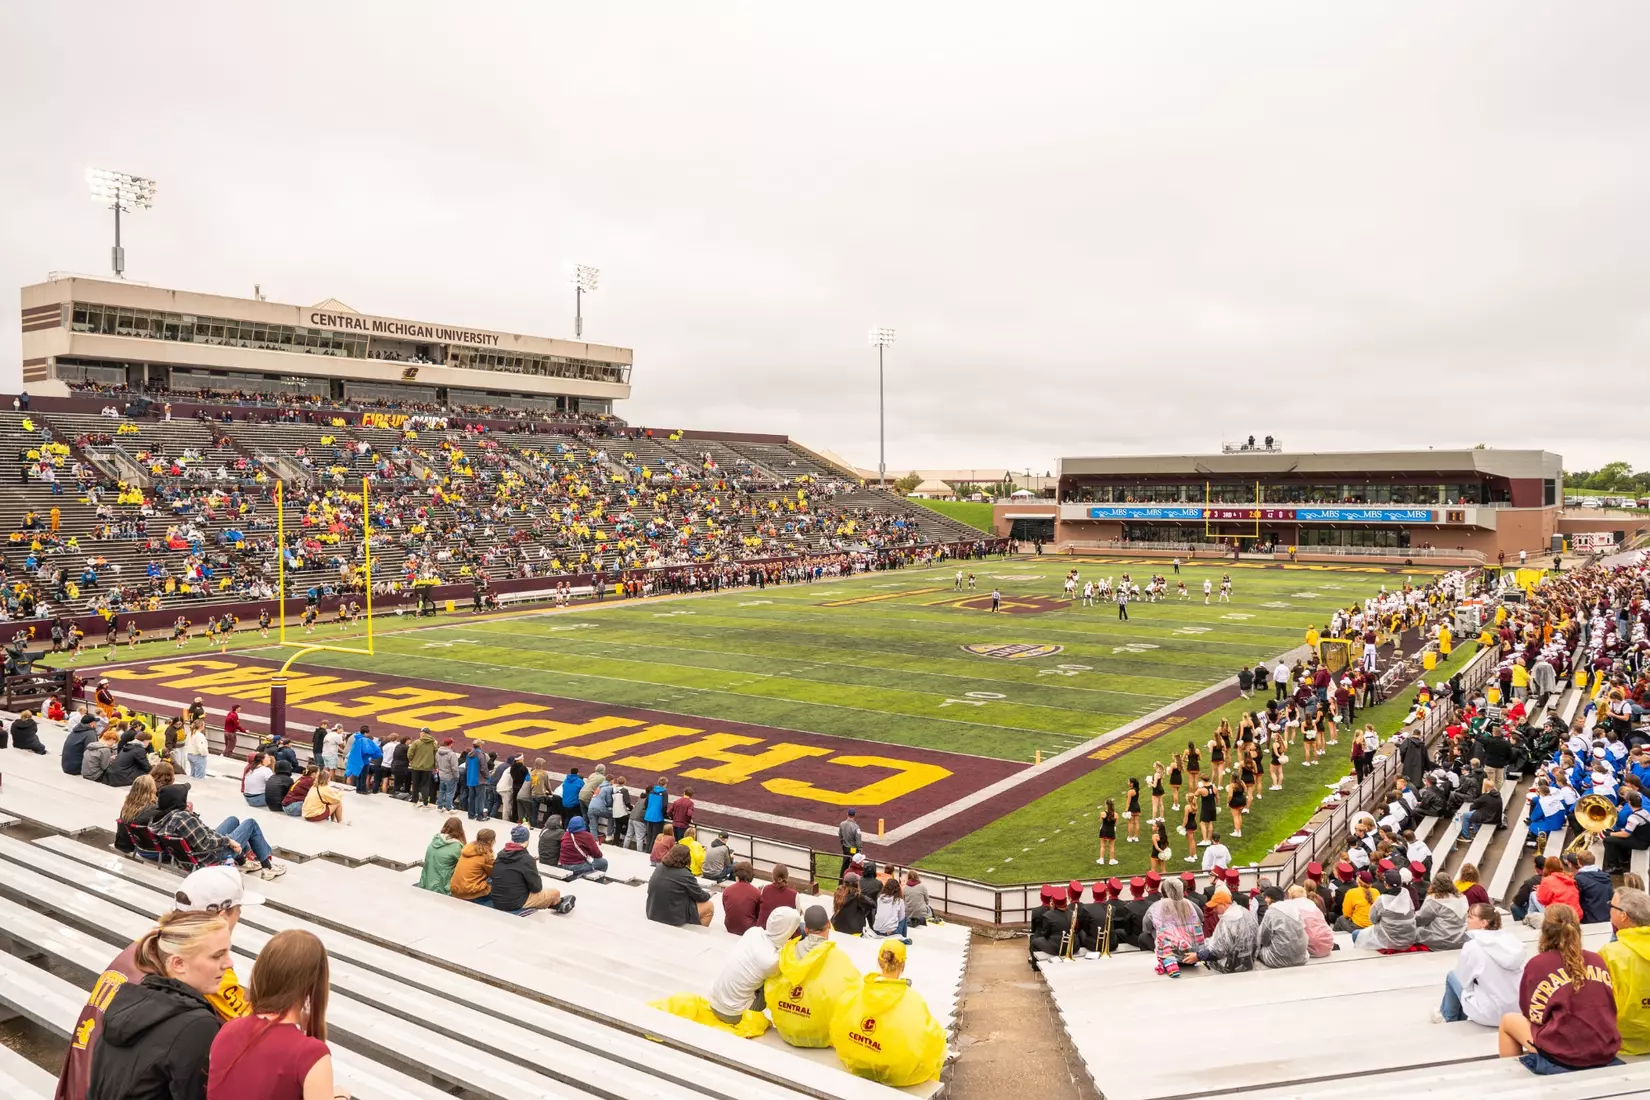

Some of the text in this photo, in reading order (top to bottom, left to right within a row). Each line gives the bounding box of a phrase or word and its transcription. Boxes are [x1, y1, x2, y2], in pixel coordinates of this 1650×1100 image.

[310, 312, 500, 346] CENTRAL MICHIGAN UNIVERSITY
[1111, 508, 1127, 516] MBS
[1146, 508, 1162, 516] MBS
[1182, 508, 1198, 516] MBS
[1321, 510, 1340, 518] MBS
[1363, 510, 1382, 518] MBS
[1407, 510, 1426, 518] MBS
[938, 691, 1007, 708] 10
[97, 658, 954, 807] CHIPPEWAS
[778, 1000, 811, 1016] CENTRAL
[848, 1031, 882, 1051] CENTRAL
